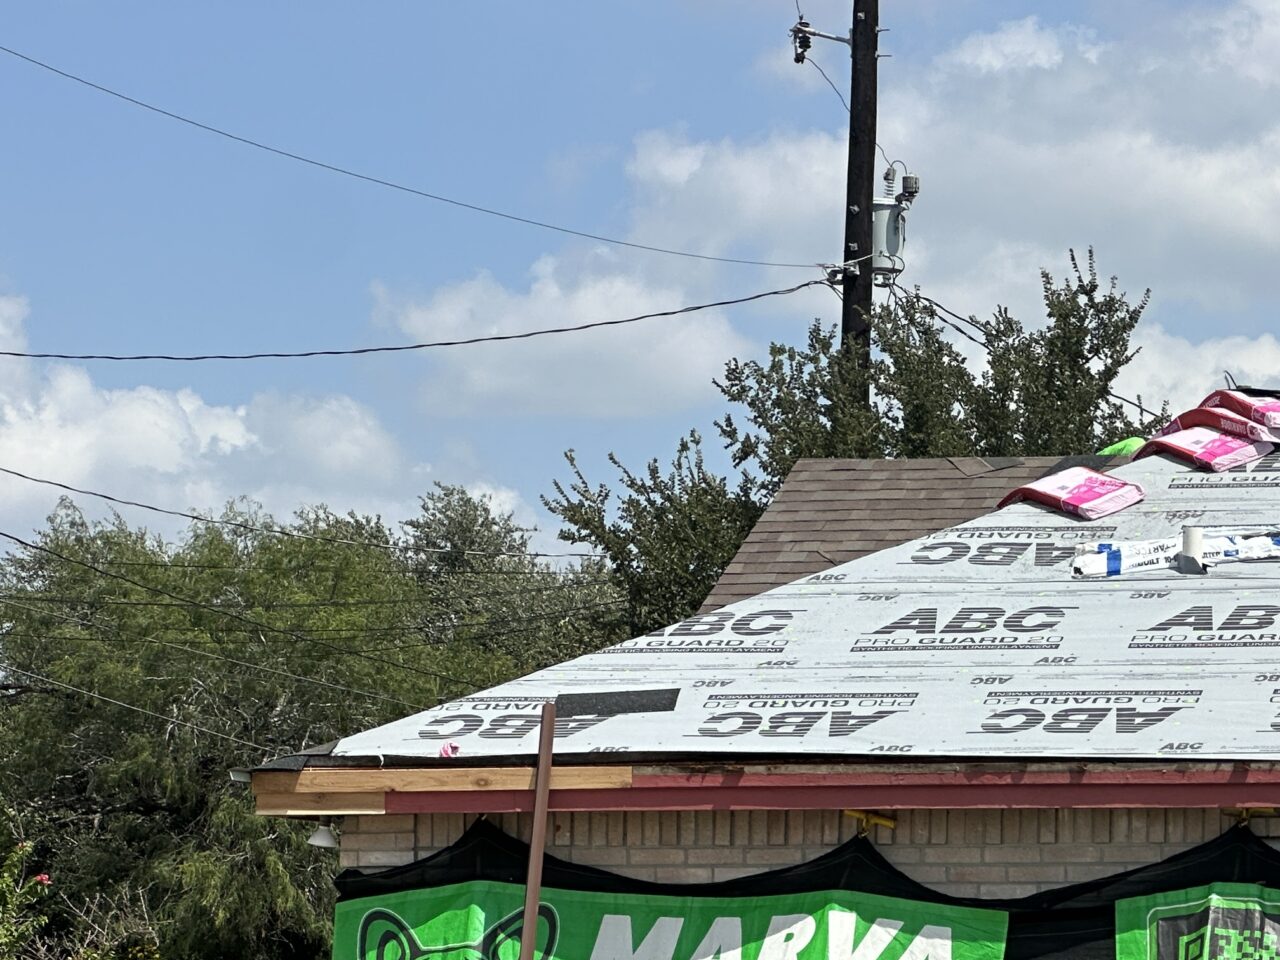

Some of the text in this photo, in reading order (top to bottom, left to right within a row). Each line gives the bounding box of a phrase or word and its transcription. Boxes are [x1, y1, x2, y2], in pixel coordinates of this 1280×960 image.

[870, 607, 1065, 634] ABC
[646, 639, 744, 647] GUARD
[918, 637, 1020, 646] GUARD
[1034, 656, 1078, 664] ABC
[692, 680, 736, 688] ABC
[970, 676, 1014, 684] ABC
[748, 700, 849, 708] GUARD
[698, 711, 903, 736] ABC
[981, 708, 1186, 734] ABC
[870, 744, 912, 752] ABC
[1160, 742, 1204, 750] ABC
